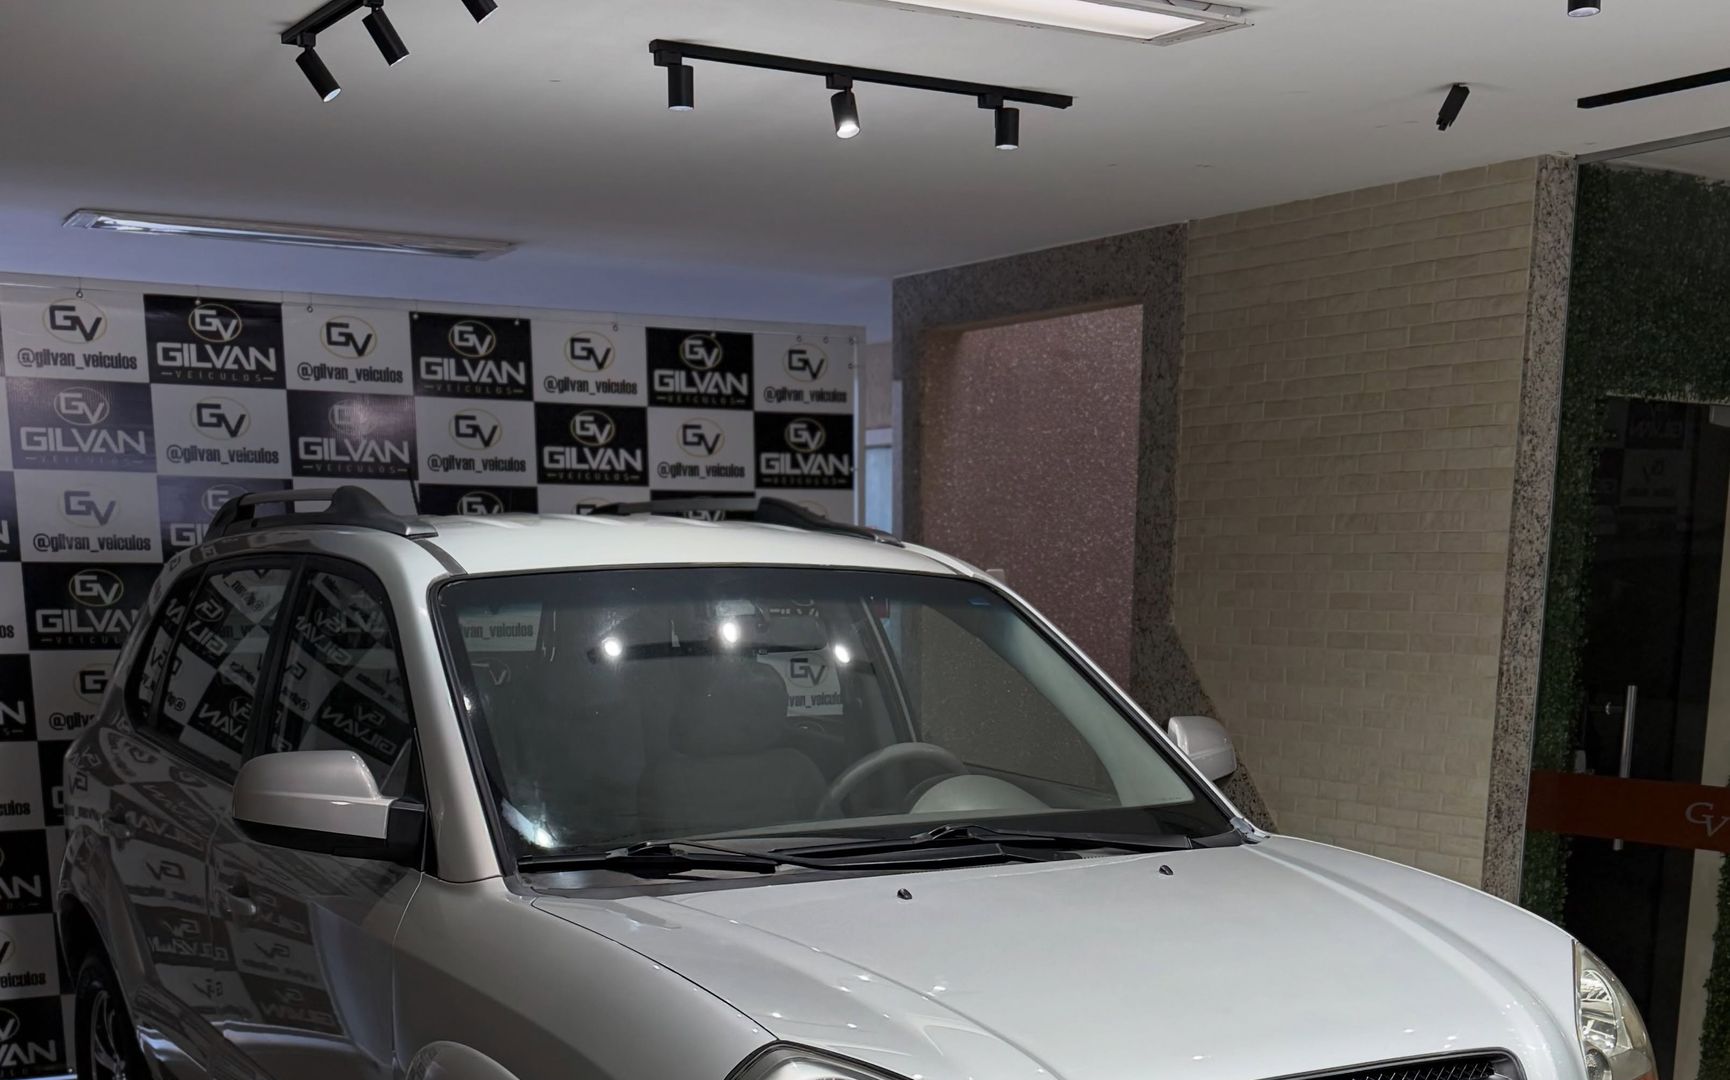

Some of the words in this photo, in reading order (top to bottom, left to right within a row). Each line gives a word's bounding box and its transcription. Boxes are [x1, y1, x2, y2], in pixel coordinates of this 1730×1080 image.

[49, 305, 103, 341] GV
[194, 307, 238, 341] GV
[326, 322, 373, 356] GV
[453, 325, 493, 355] GV
[684, 339, 718, 367] GV
[17, 348, 137, 370] @gilvan_veiculos
[156, 342, 277, 373] GILVAN
[570, 337, 611, 370] GV
[788, 349, 825, 380] GV
[297, 362, 403, 384] @gilvan_veiculos
[420, 356, 526, 385] GILVAN
[653, 369, 748, 395] GILVAN
[544, 375, 638, 395] @gilvan_veiculos
[58, 391, 106, 424] GV
[196, 402, 247, 438] GV
[20, 427, 146, 454] GILVAN
[454, 414, 499, 448] GV
[574, 416, 611, 443] GV
[682, 424, 721, 455] GV
[789, 423, 822, 450] GV
[166, 444, 279, 465] @gilvan_veiculos
[299, 436, 410, 464] GILVAN
[427, 454, 526, 473] @gilvan_veiculos
[543, 446, 643, 471] GILVAN
[760, 452, 851, 476] GILVAN
[64, 490, 116, 525] GV
[33, 534, 151, 553] @gilvan_veiculos
[73, 575, 119, 604] GV
